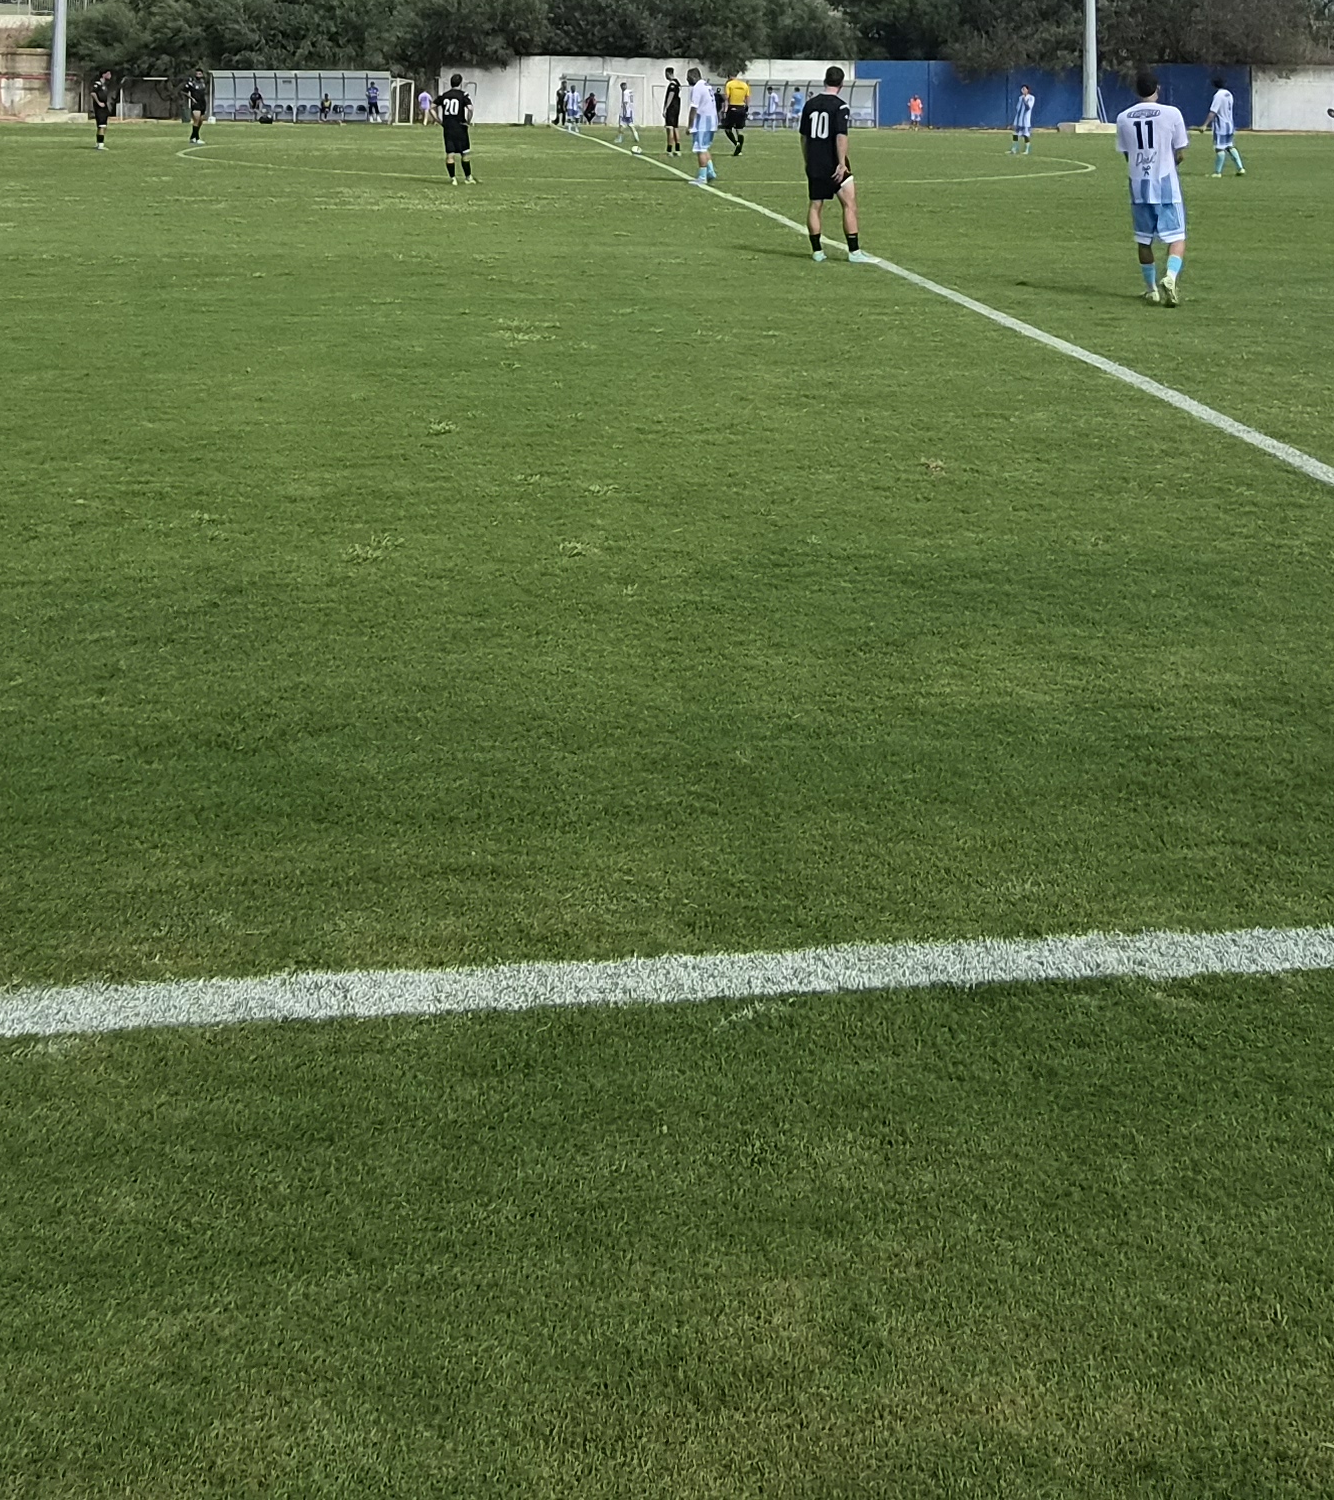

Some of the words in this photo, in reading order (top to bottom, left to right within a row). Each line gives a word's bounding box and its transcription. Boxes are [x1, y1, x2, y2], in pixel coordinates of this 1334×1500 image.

[443, 98, 460, 116] 20
[809, 110, 830, 140] 10
[1133, 119, 1155, 150] 11
